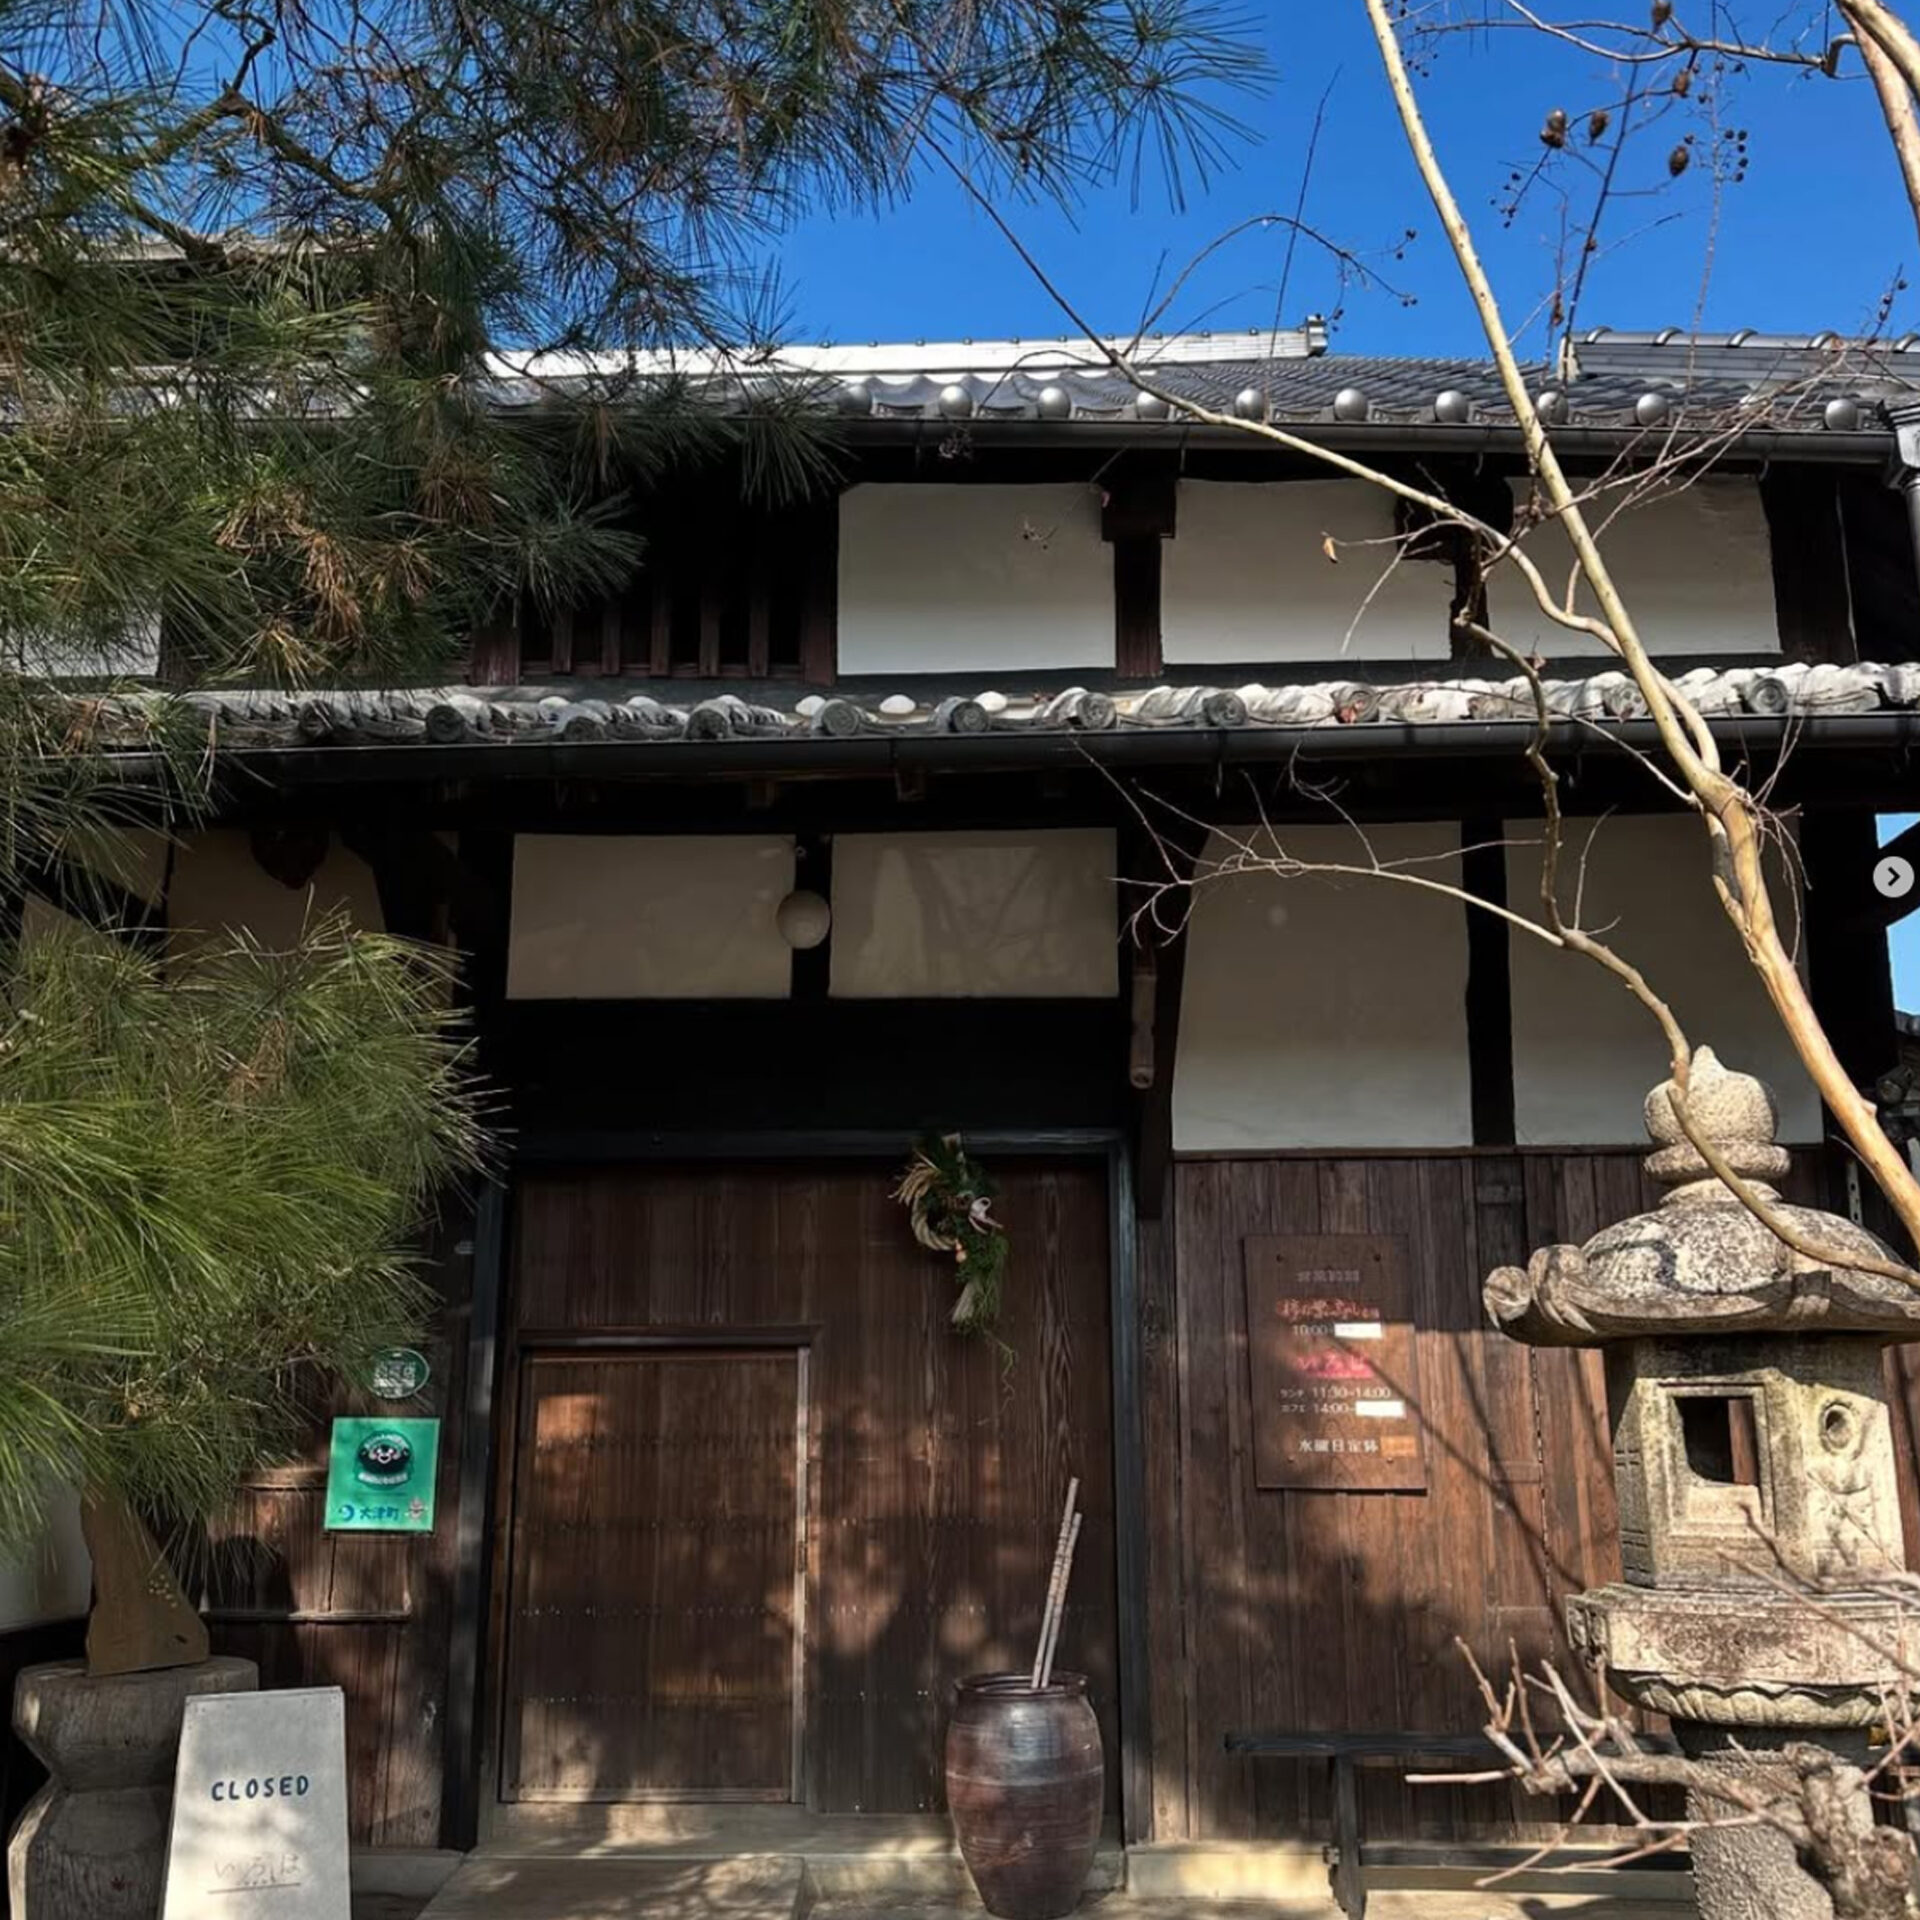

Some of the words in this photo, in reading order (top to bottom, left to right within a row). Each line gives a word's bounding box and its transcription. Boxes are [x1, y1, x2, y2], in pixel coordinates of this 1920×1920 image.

[360, 1506, 399, 1521] 大津町
[211, 1775, 309, 1801] CLOSED
